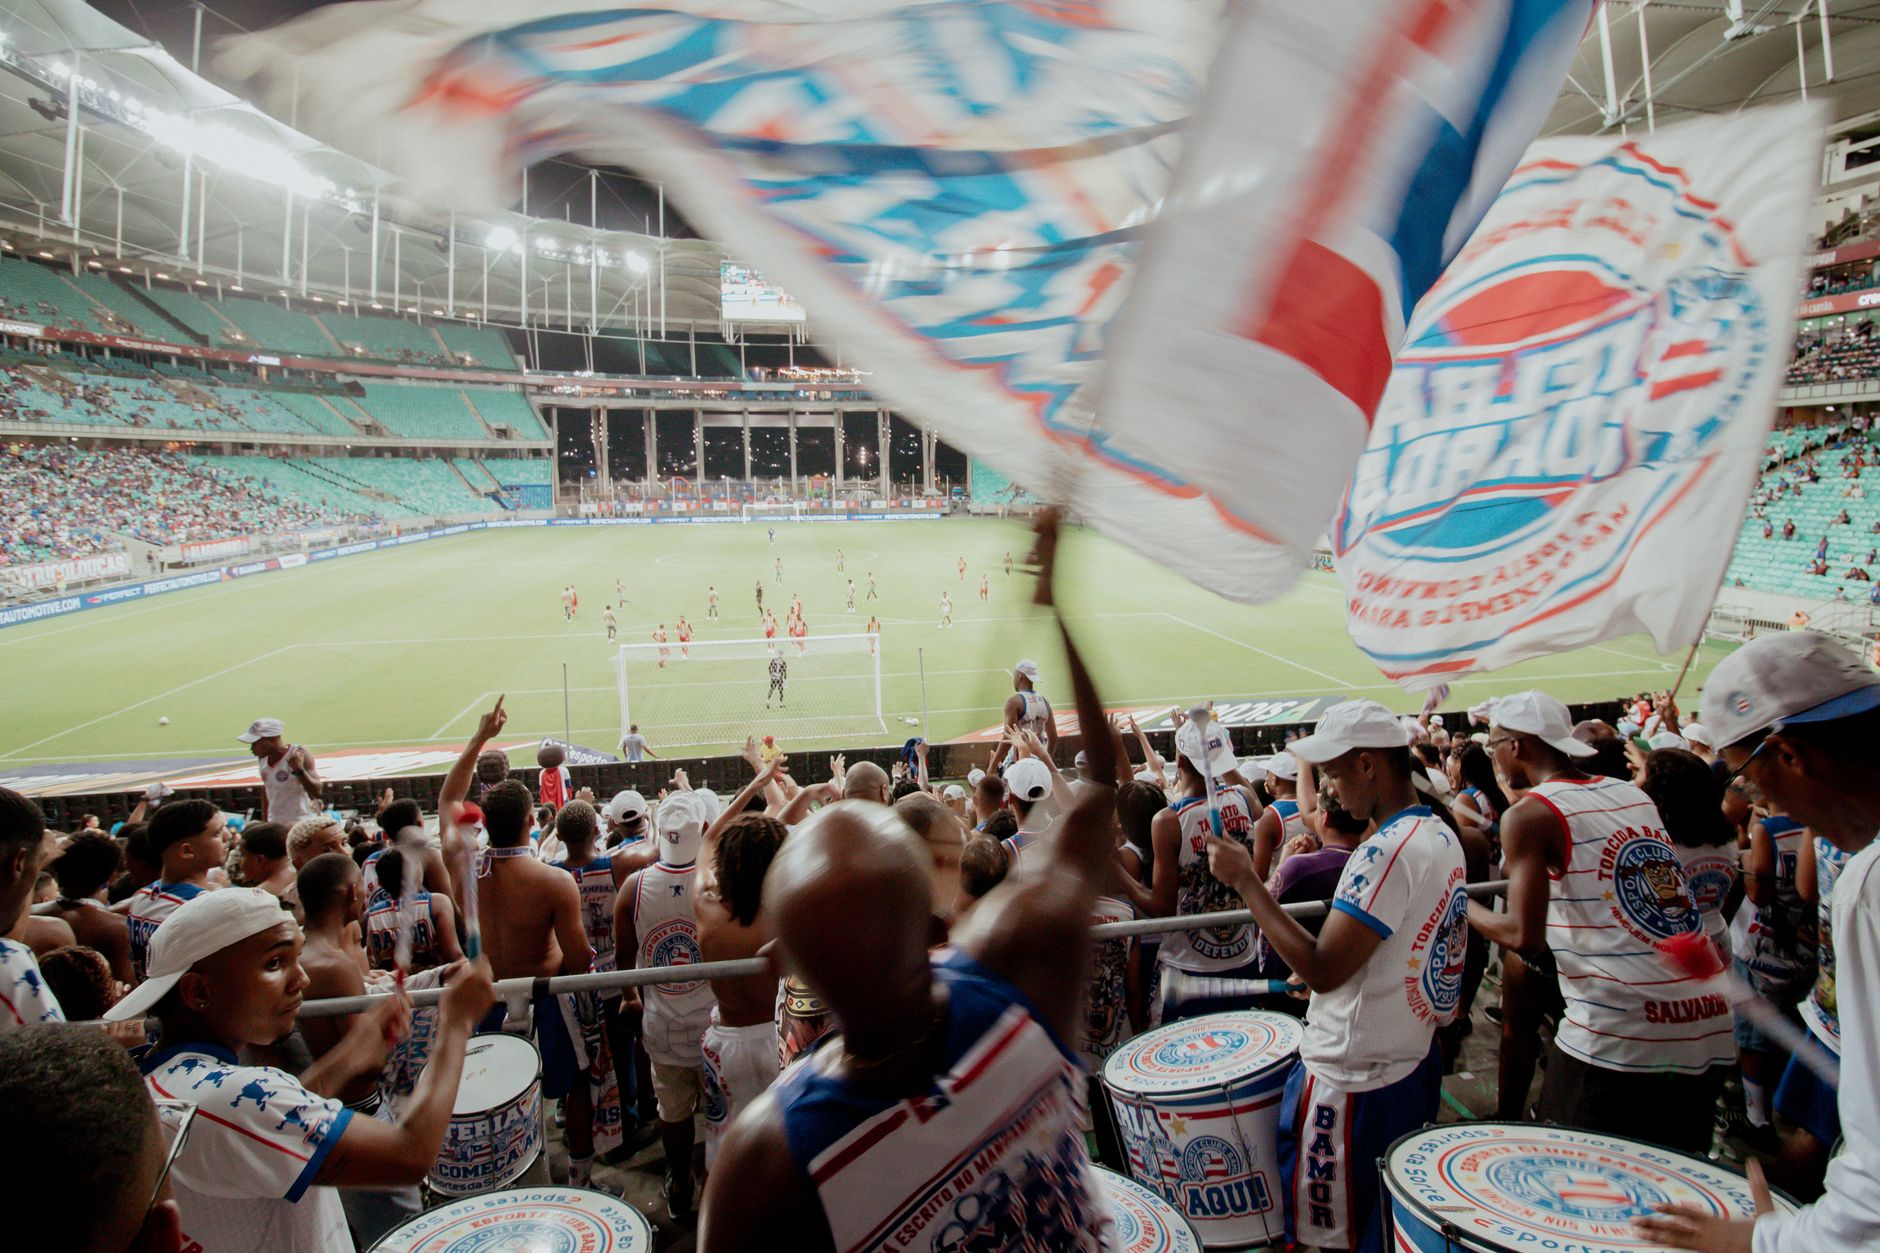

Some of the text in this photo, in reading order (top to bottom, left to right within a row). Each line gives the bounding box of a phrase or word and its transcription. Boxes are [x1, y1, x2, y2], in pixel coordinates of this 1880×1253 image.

[1598, 826, 1640, 882] TORCIDA
[1411, 889, 1450, 953] TORCIDA
[1644, 992, 1729, 1024] SALVADOR
[1305, 1103, 1339, 1230] BAMOR
[1404, 1129, 1505, 1202] Esportes da Sorte
[1547, 1133, 1625, 1153] Sorte
[1638, 1151, 1672, 1166] da
[450, 1204, 476, 1217] da
[484, 1194, 583, 1207] Esportes
[894, 1187, 954, 1248] ESCRITO
[952, 1174, 975, 1194] NO
[1187, 1177, 1269, 1217] AQUI!
